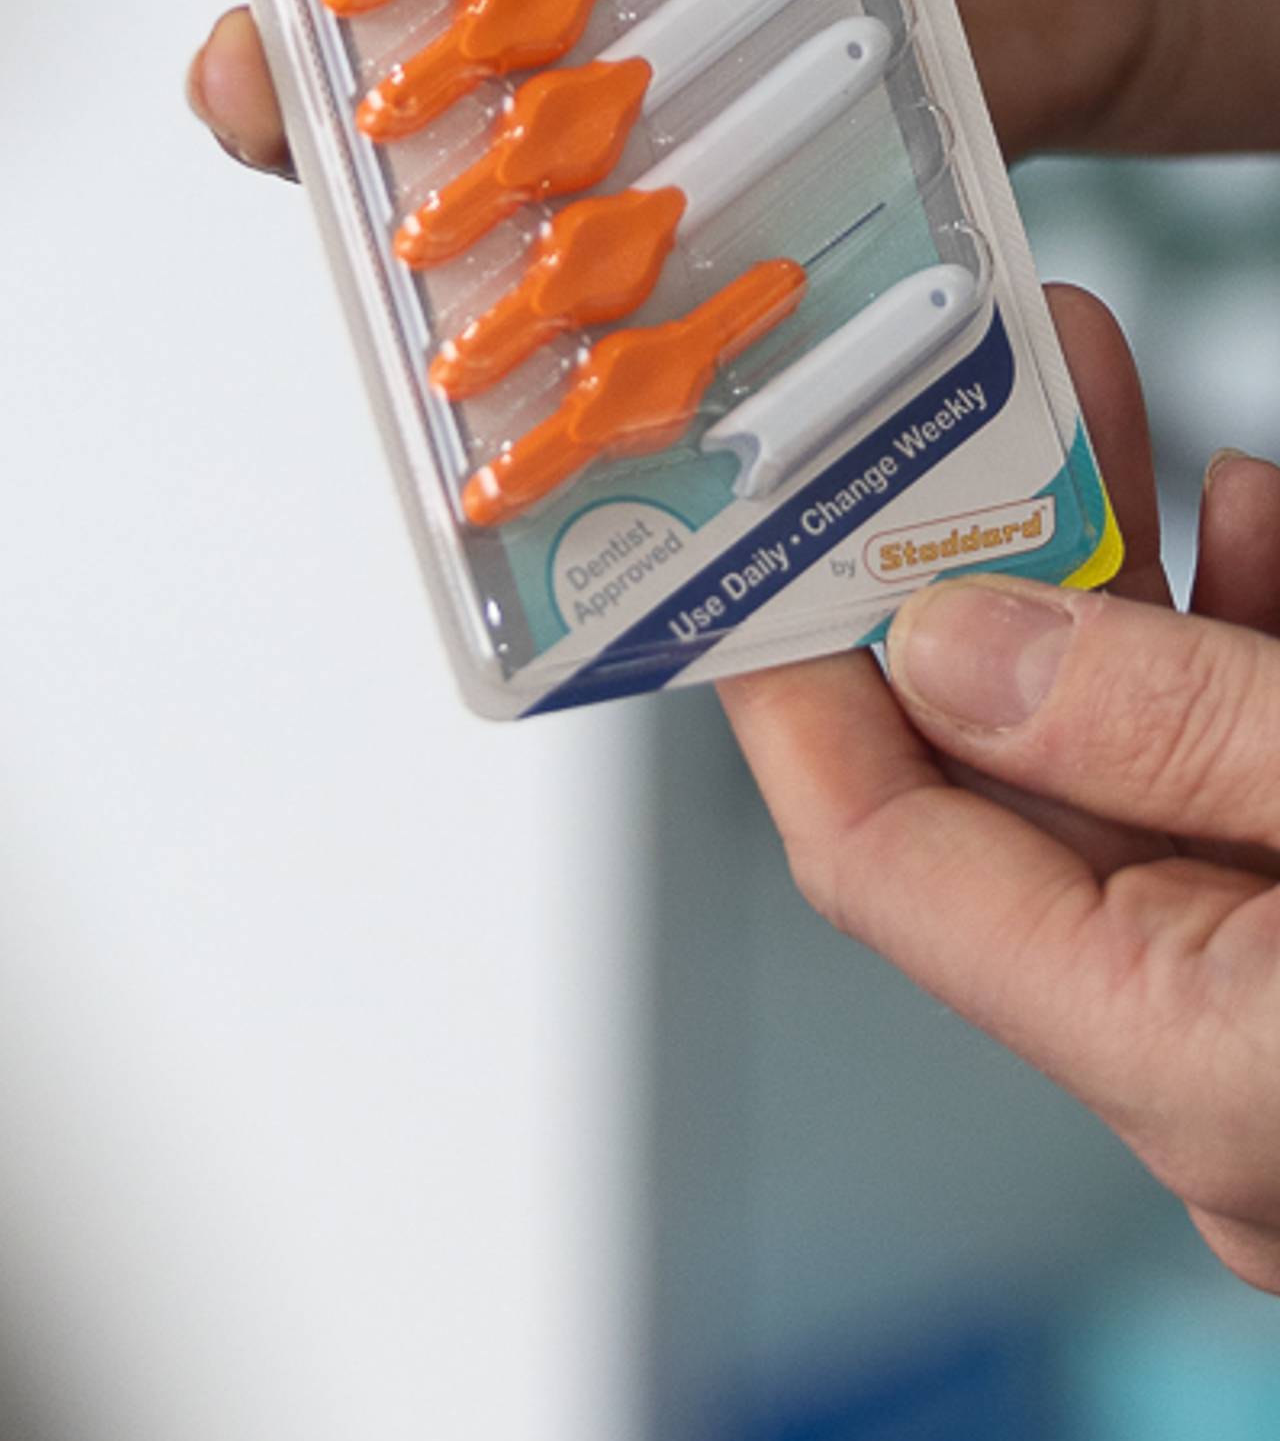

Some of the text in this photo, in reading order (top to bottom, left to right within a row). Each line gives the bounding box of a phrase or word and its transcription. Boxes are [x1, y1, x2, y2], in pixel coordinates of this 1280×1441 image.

[565, 517, 655, 592] Dentist
[667, 381, 989, 643] Use Daily Change Weekly
[828, 509, 1044, 579] by Stoddard
[572, 527, 685, 625] Approved
